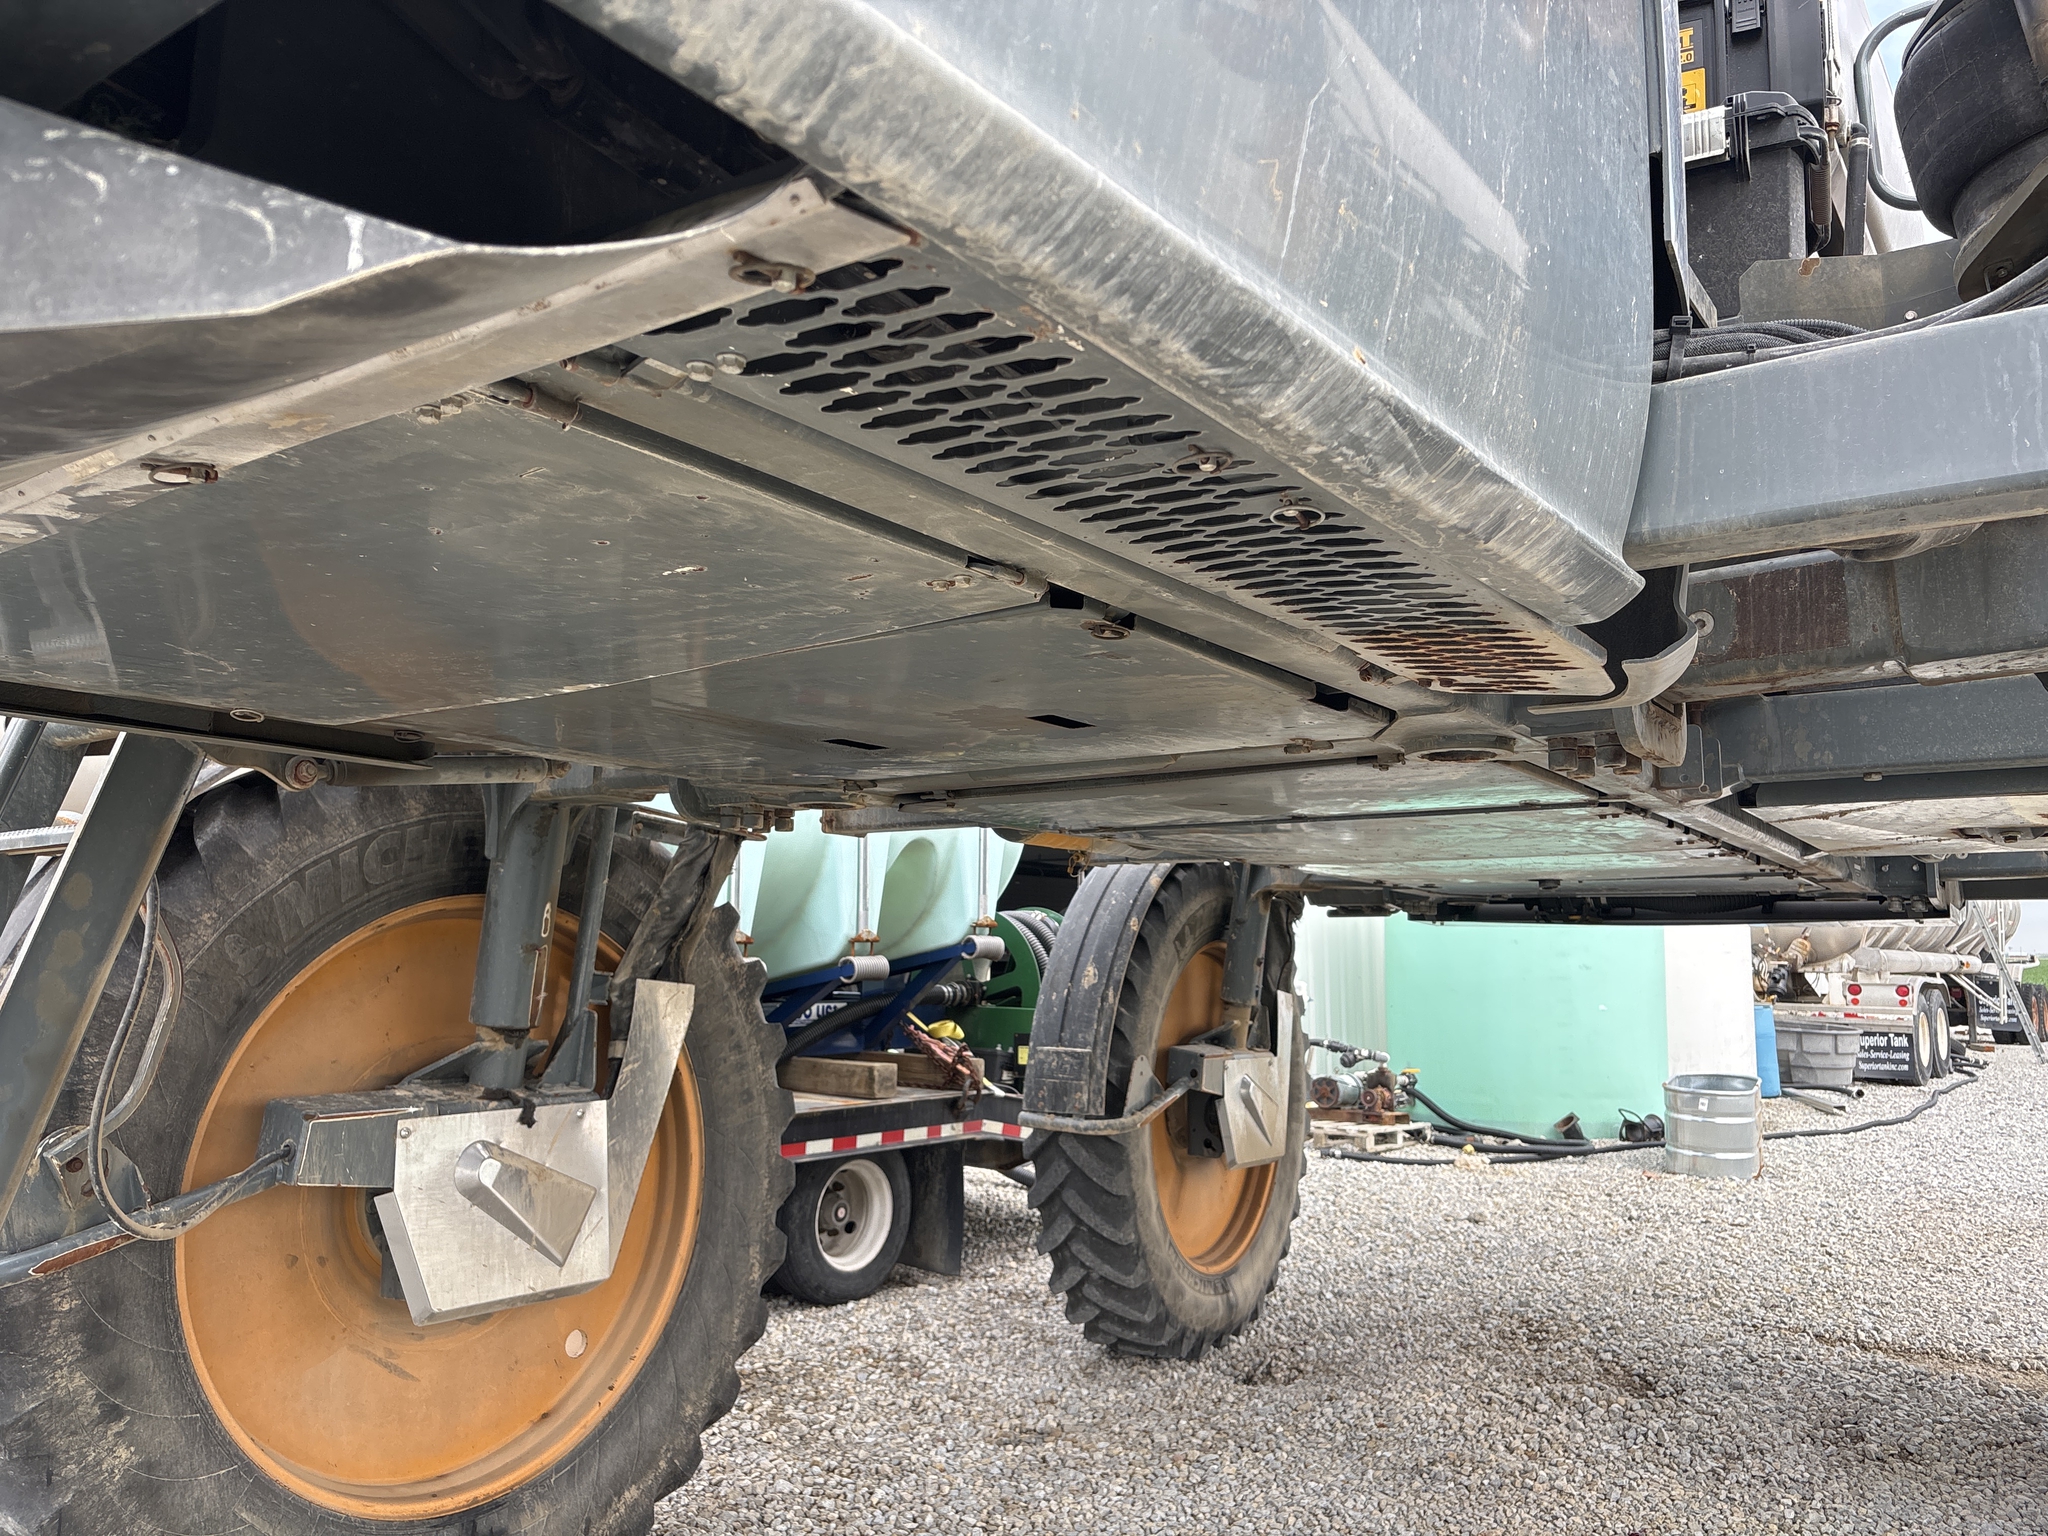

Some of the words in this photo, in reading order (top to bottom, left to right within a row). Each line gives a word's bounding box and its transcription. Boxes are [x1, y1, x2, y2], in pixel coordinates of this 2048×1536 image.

[273, 820, 485, 955] MICHE
[1860, 1033, 1888, 1049] uperior
[1888, 1033, 1909, 1047] Tank
[1859, 1061, 1909, 1072] Superiortankinc.com
